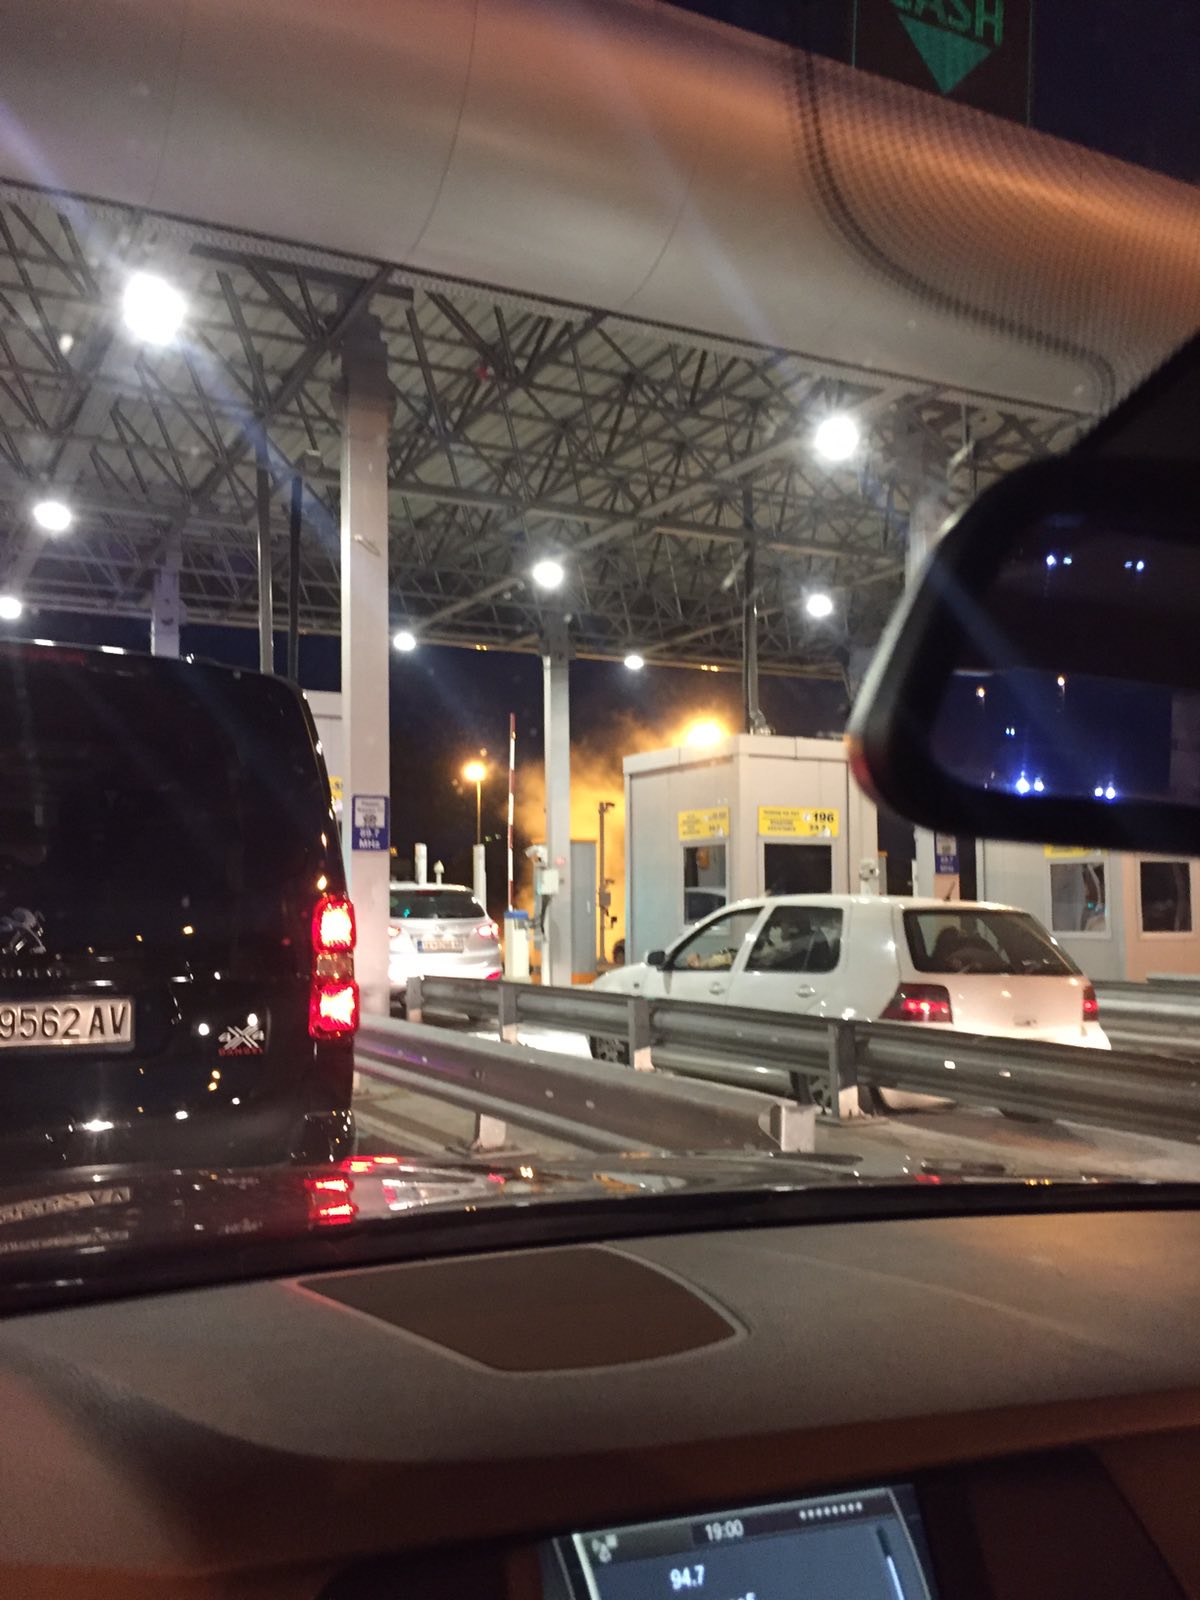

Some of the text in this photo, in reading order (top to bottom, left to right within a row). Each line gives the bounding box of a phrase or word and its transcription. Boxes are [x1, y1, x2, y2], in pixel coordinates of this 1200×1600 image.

[891, 0, 1003, 46] SH
[814, 812, 834, 823] 196
[0, 1004, 127, 1040] 9562 AV
[705, 1519, 744, 1541] 19:00
[670, 1564, 704, 1590] 94.7
